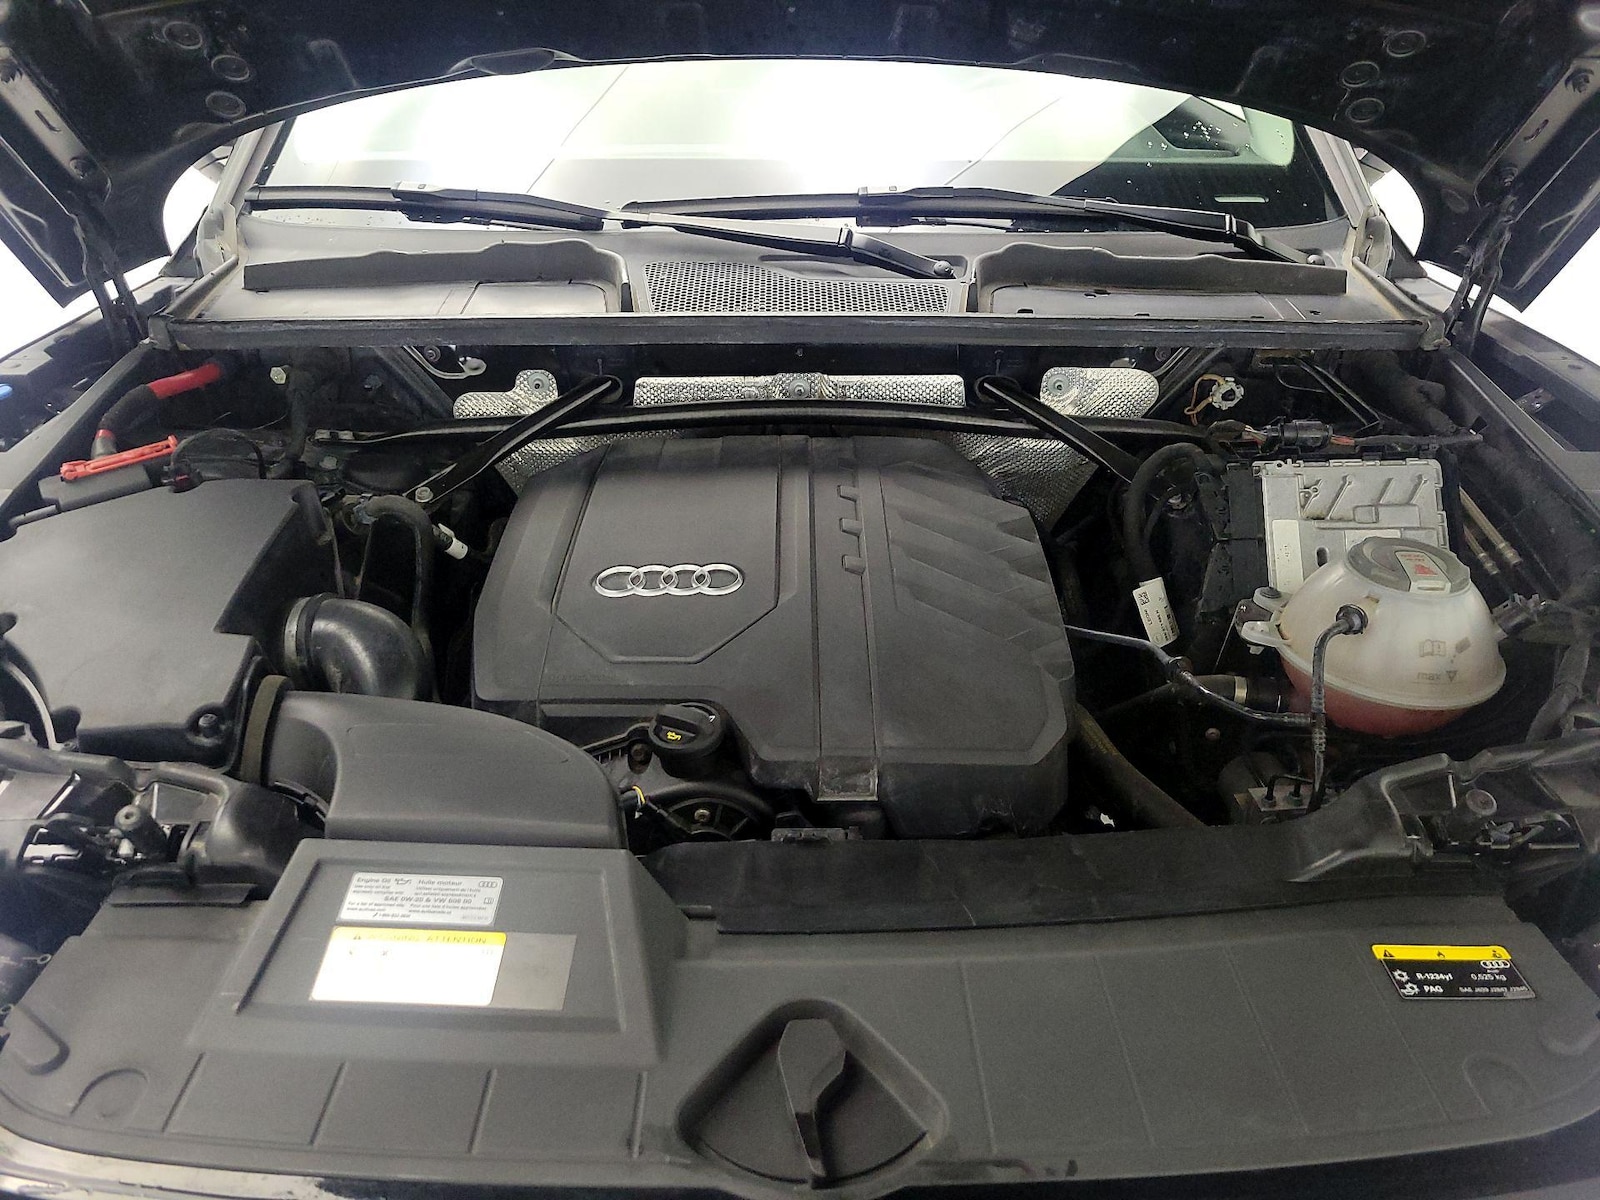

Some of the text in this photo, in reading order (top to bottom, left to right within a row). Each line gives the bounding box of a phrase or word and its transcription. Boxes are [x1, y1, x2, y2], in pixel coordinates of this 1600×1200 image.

[1417, 671, 1441, 681] max
[426, 934, 487, 944] ATTENTION
[1423, 984, 1444, 993] PAG
